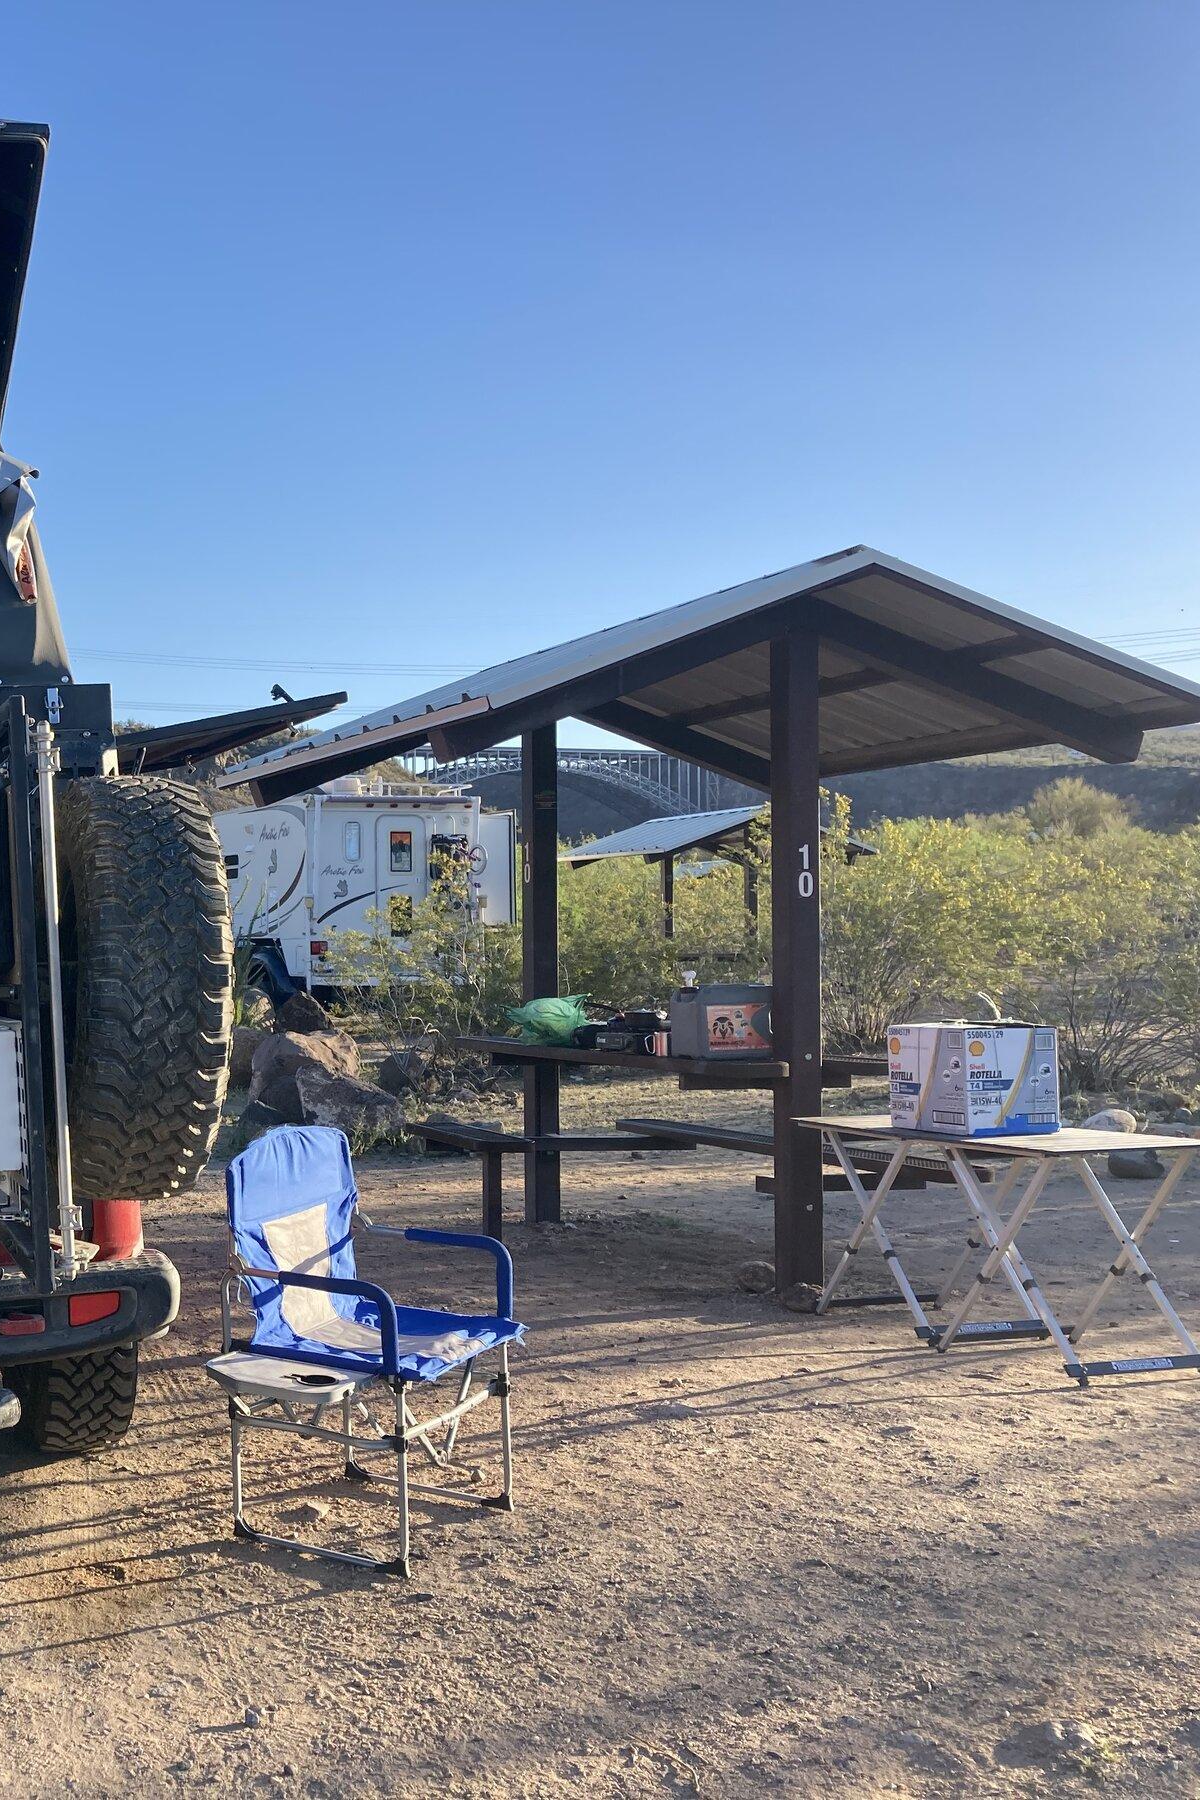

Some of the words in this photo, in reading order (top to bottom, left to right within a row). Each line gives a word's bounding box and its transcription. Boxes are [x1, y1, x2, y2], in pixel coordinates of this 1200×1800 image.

[320, 865, 347, 876] Arctic
[798, 844, 814, 897] 10
[891, 1071, 913, 1081] ROTELLA
[970, 1070, 1002, 1080] ROTELLA
[970, 1082, 980, 1090] T4
